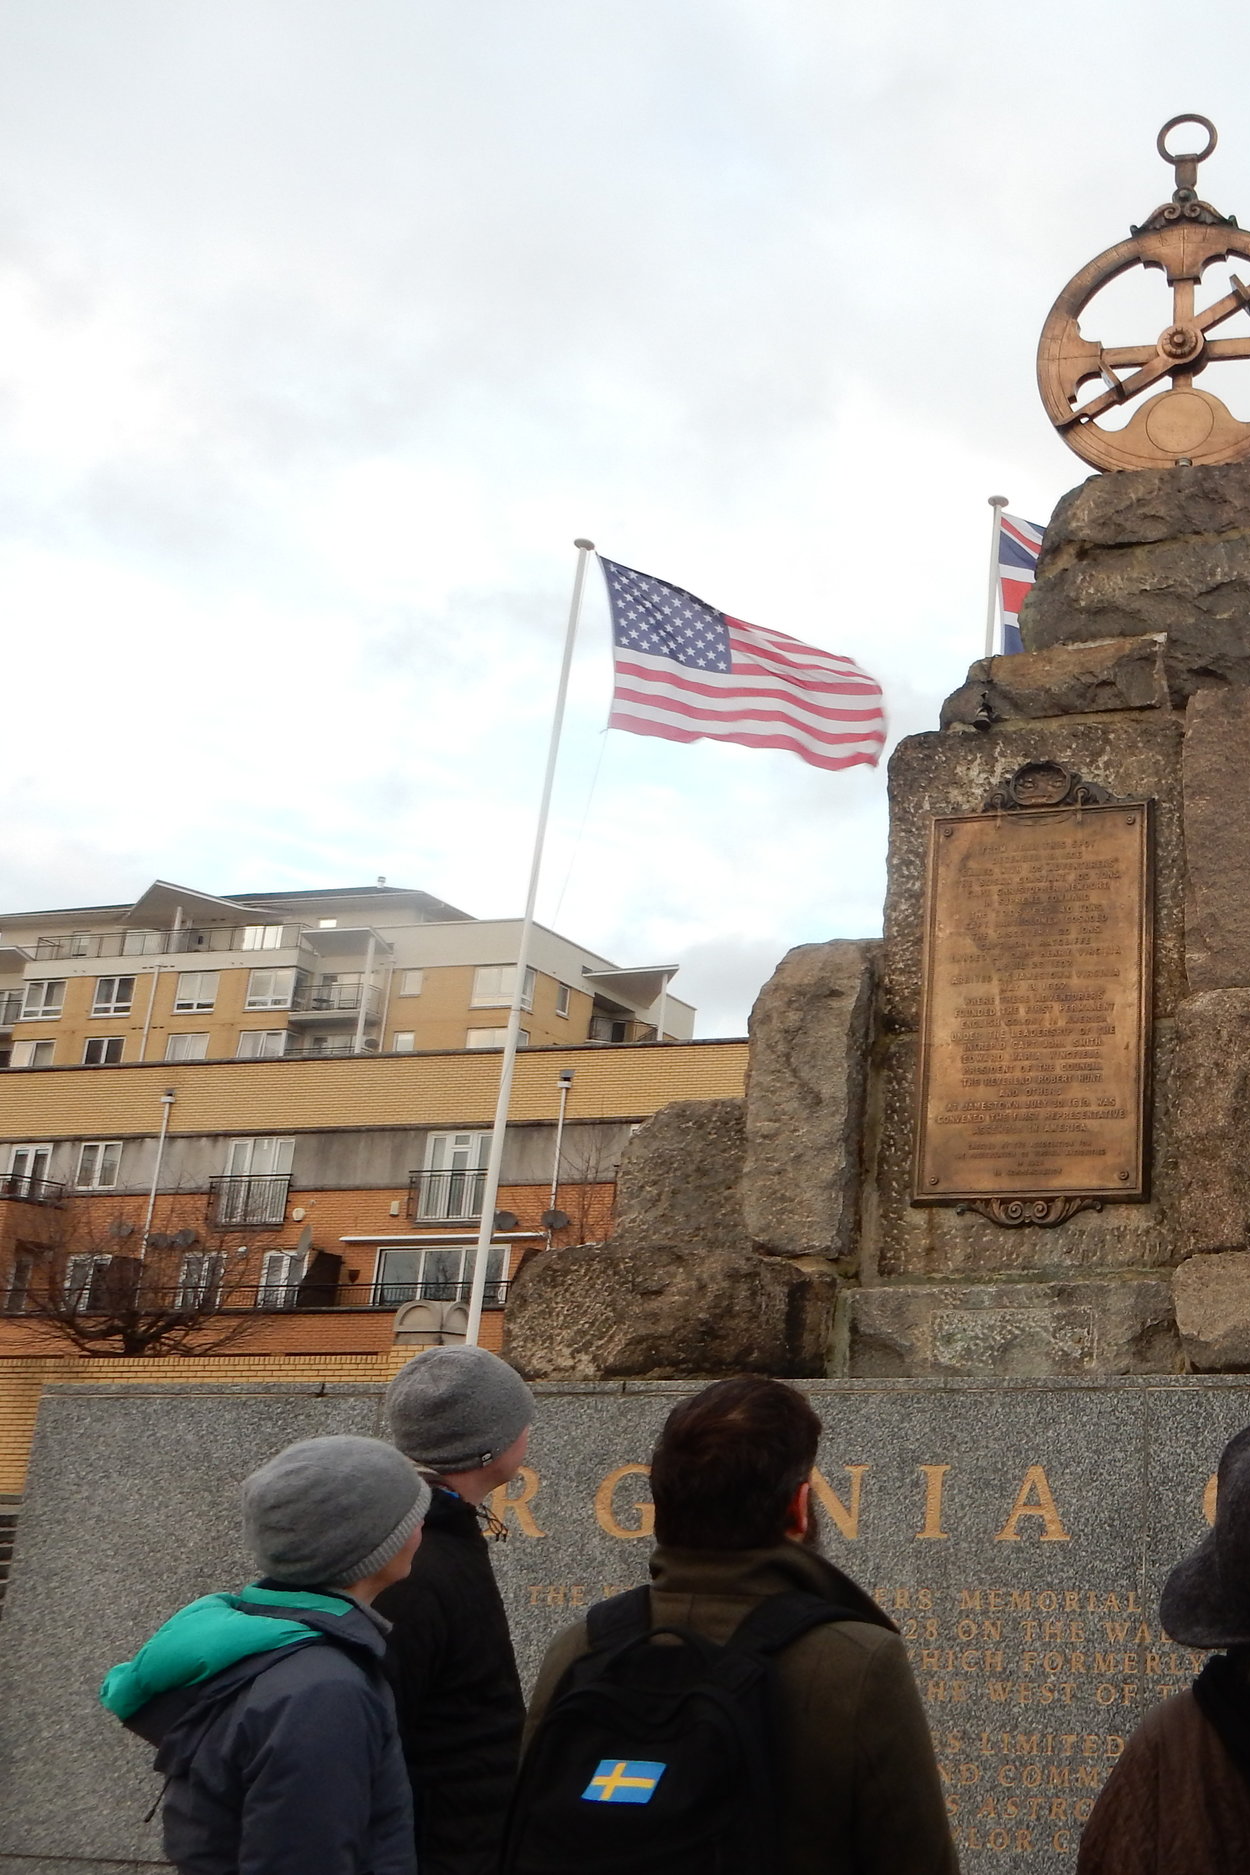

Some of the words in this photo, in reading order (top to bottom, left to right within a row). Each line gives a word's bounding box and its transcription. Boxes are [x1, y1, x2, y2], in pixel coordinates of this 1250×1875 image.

[954, 1005, 996, 1018] FOUNDED
[528, 1585, 586, 1606] THE
[959, 1589, 1142, 1613] MEMORIAL
[957, 1619, 1004, 1641] ON
[1020, 1621, 1087, 1643] THE
[907, 1649, 1005, 1672] HICH
[1022, 1651, 1207, 1676] FORMERLY
[916, 1679, 968, 1702] HE
[984, 1680, 1078, 1704] WEST
[1096, 1684, 1139, 1706] OF
[979, 1732, 1126, 1757] LIMITED
